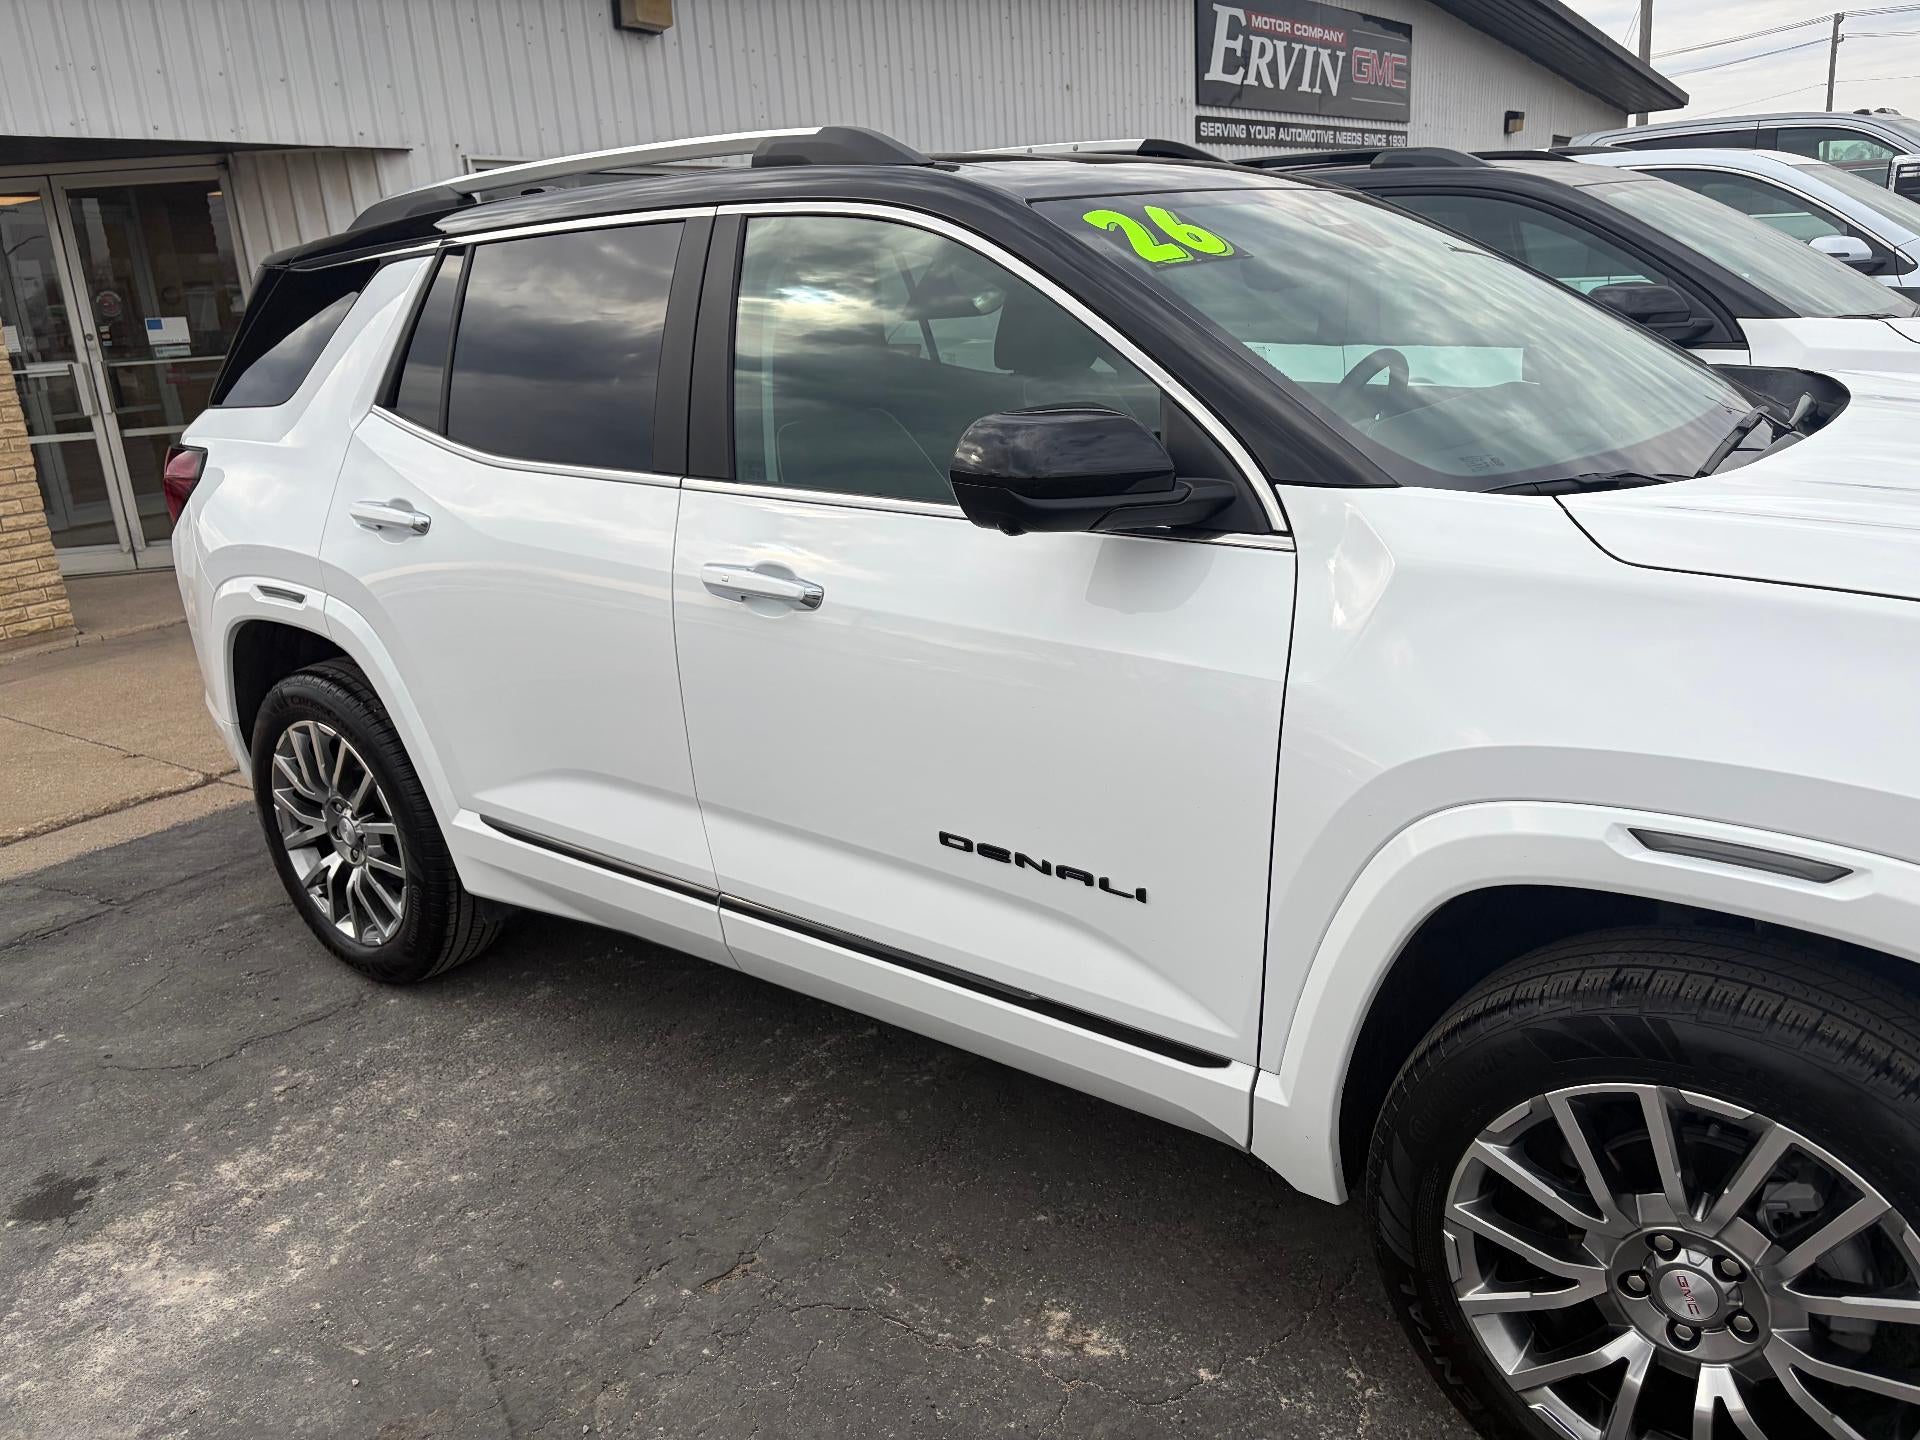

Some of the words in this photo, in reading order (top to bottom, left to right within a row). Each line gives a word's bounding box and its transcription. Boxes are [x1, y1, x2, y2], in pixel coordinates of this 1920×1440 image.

[1203, 3, 1346, 97] ERVIN
[1251, 15, 1291, 33] MOTOR
[1294, 24, 1343, 43] COMPANY
[1352, 47, 1408, 89] GMC
[1200, 122, 1247, 138] SERVING
[1249, 125, 1277, 140] YOUR
[1278, 128, 1335, 143] AUTOMOTIVE
[1336, 131, 1362, 145] NEEDS
[1364, 133, 1387, 147] SINCE
[1083, 205, 1235, 264] 26
[939, 830, 1147, 903] DENALI
[1676, 1275, 1700, 1315] GMC
